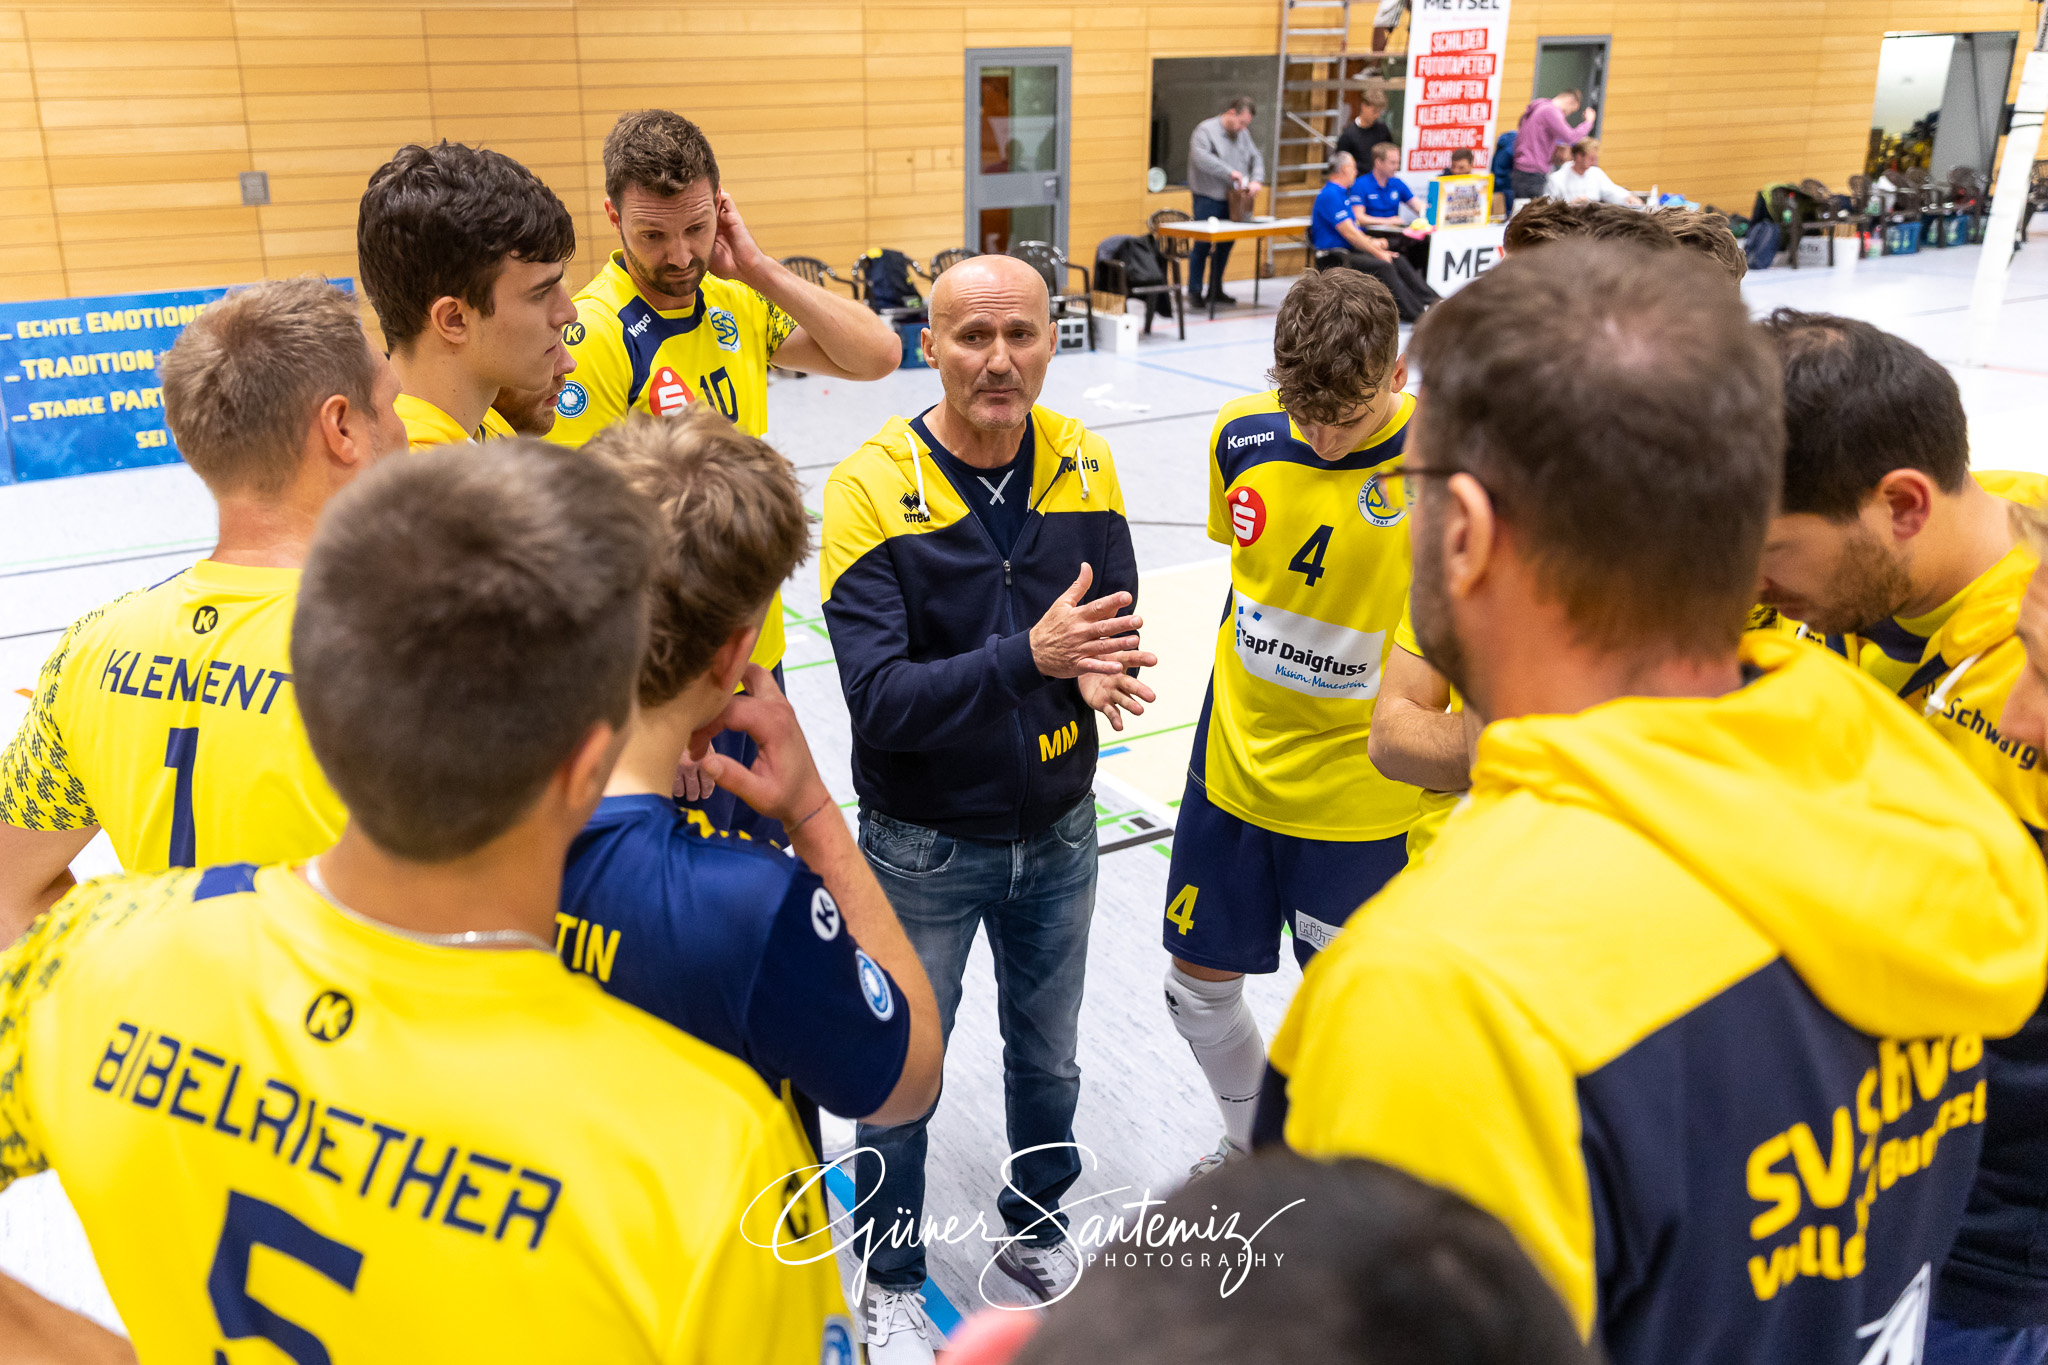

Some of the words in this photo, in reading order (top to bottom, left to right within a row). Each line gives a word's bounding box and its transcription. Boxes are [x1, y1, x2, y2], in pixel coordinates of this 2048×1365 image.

[1433, 30, 1485, 52] SCHILDER
[1418, 56, 1493, 75] FOTOTAPETEN
[1426, 81, 1484, 100] SCHRIFTEN
[1418, 103, 1488, 124] KLEBEFOLIEN
[17, 316, 82, 340] ECHTE
[20, 350, 154, 381] TRADITION
[28, 396, 105, 421] STARKE
[700, 366, 738, 423] 10
[135, 429, 168, 449] SEI
[1227, 430, 1275, 449] Kempa
[1372, 518, 1389, 526] 1967
[1288, 524, 1334, 587] 4
[1279, 642, 1368, 677] Daigfuss
[100, 648, 294, 715] KLEMENT
[1038, 720, 1079, 762] MM
[164, 727, 199, 868] 1
[1166, 883, 1199, 936] 4
[92, 1021, 563, 1252] BIBELRIETHER
[1746, 1105, 1855, 1241] SV
[207, 1189, 365, 1365] 5
